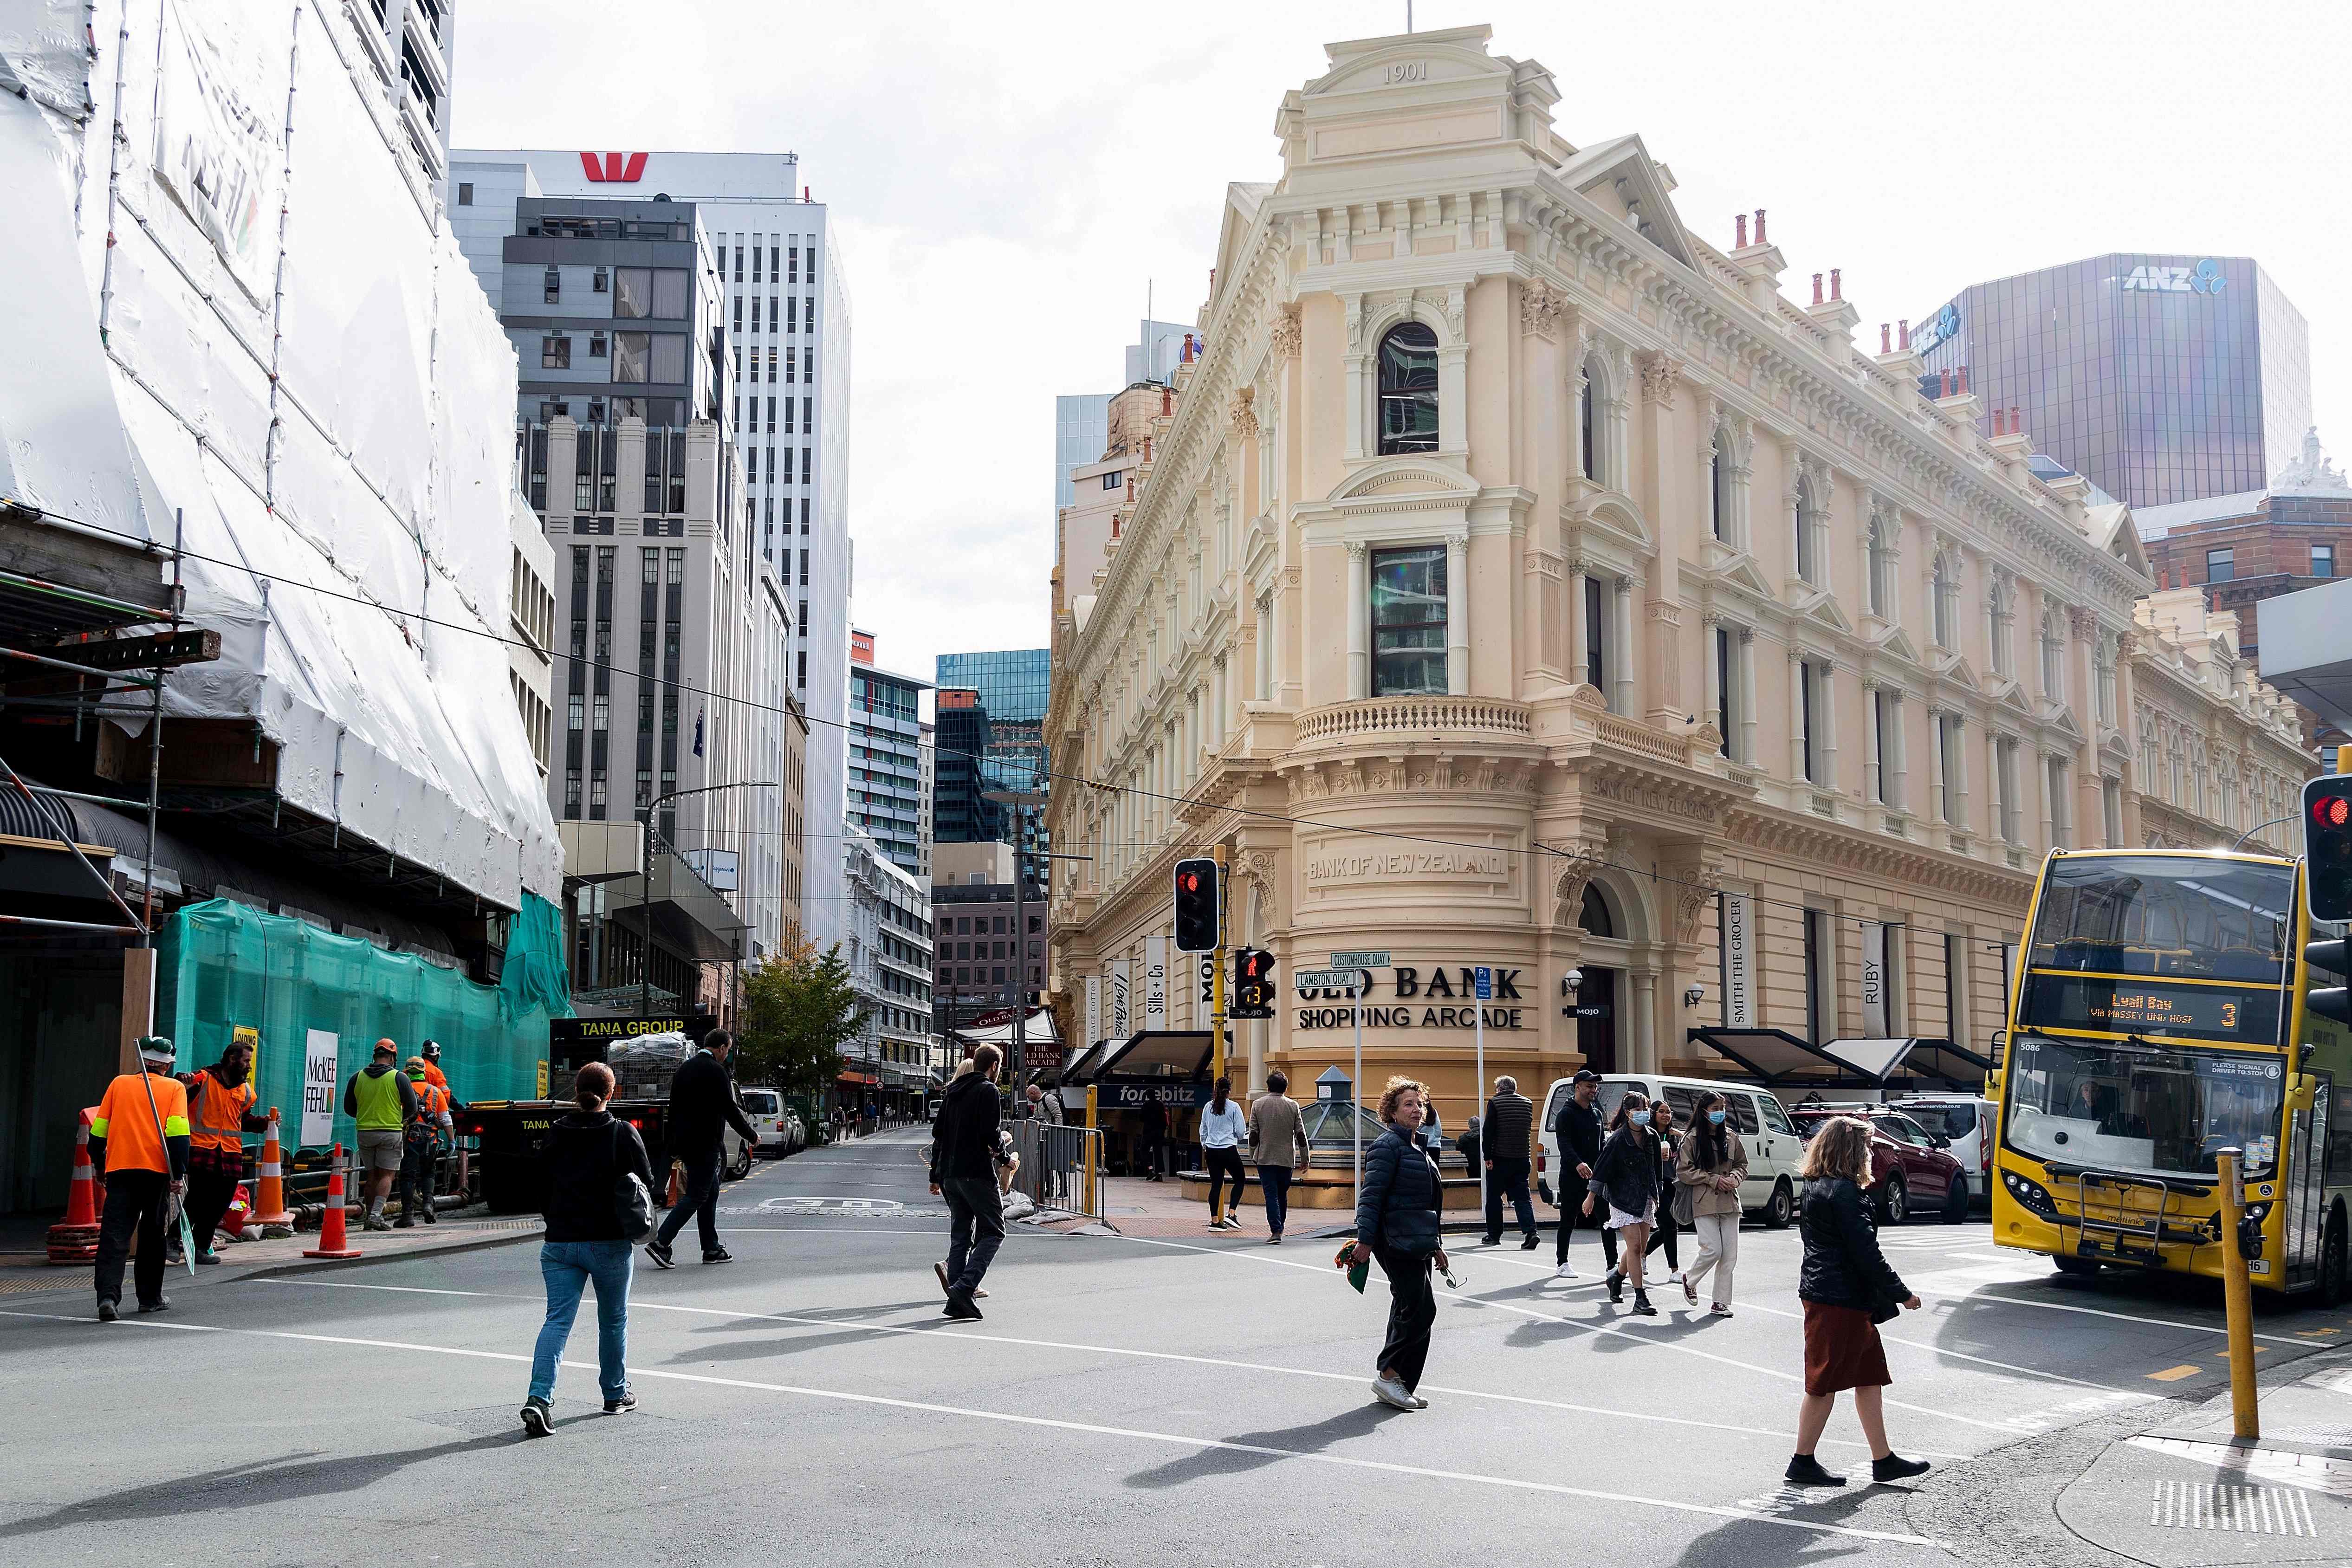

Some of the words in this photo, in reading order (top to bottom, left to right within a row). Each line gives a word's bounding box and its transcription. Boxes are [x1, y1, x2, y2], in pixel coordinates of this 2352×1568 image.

[1384, 61, 1427, 84] 1901
[2123, 266, 2191, 291] ANZ
[1309, 858, 1346, 879] BANK
[1348, 855, 1373, 875] OF
[1375, 854, 1415, 875] NEW
[1730, 900, 1742, 951] GROCER
[1334, 954, 1370, 966] CUSTOMHOUSE
[1373, 953, 1386, 965] QUAY
[1732, 953, 1743, 979] THE
[1148, 965, 1163, 978] Co
[1301, 974, 1330, 986] LAMBTON
[1333, 973, 1349, 985] QUAY
[1393, 967, 1523, 999] BANK
[1866, 960, 1879, 1004] RUBY
[1147, 991, 1163, 1014] Sills
[1733, 981, 1744, 1023] SMITH
[2111, 994, 2144, 1009] Lyall
[2147, 996, 2172, 1010] Bay
[2221, 1003, 2236, 1027] 3
[1299, 1007, 1410, 1029] SHOPPING
[1421, 1007, 1522, 1028] ARCADE
[2090, 1008, 2105, 1017] VIA
[2108, 1009, 2144, 1020] MASSEY
[235, 1032, 256, 1046] LOADING
[580, 1023, 622, 1035] TANA
[627, 1020, 684, 1035] GROUP
[307, 1055, 336, 1083] McKEE
[305, 1086, 325, 1113] FEHL
[522, 1120, 550, 1129] TANA
[2107, 1215, 2140, 1225] metlink
